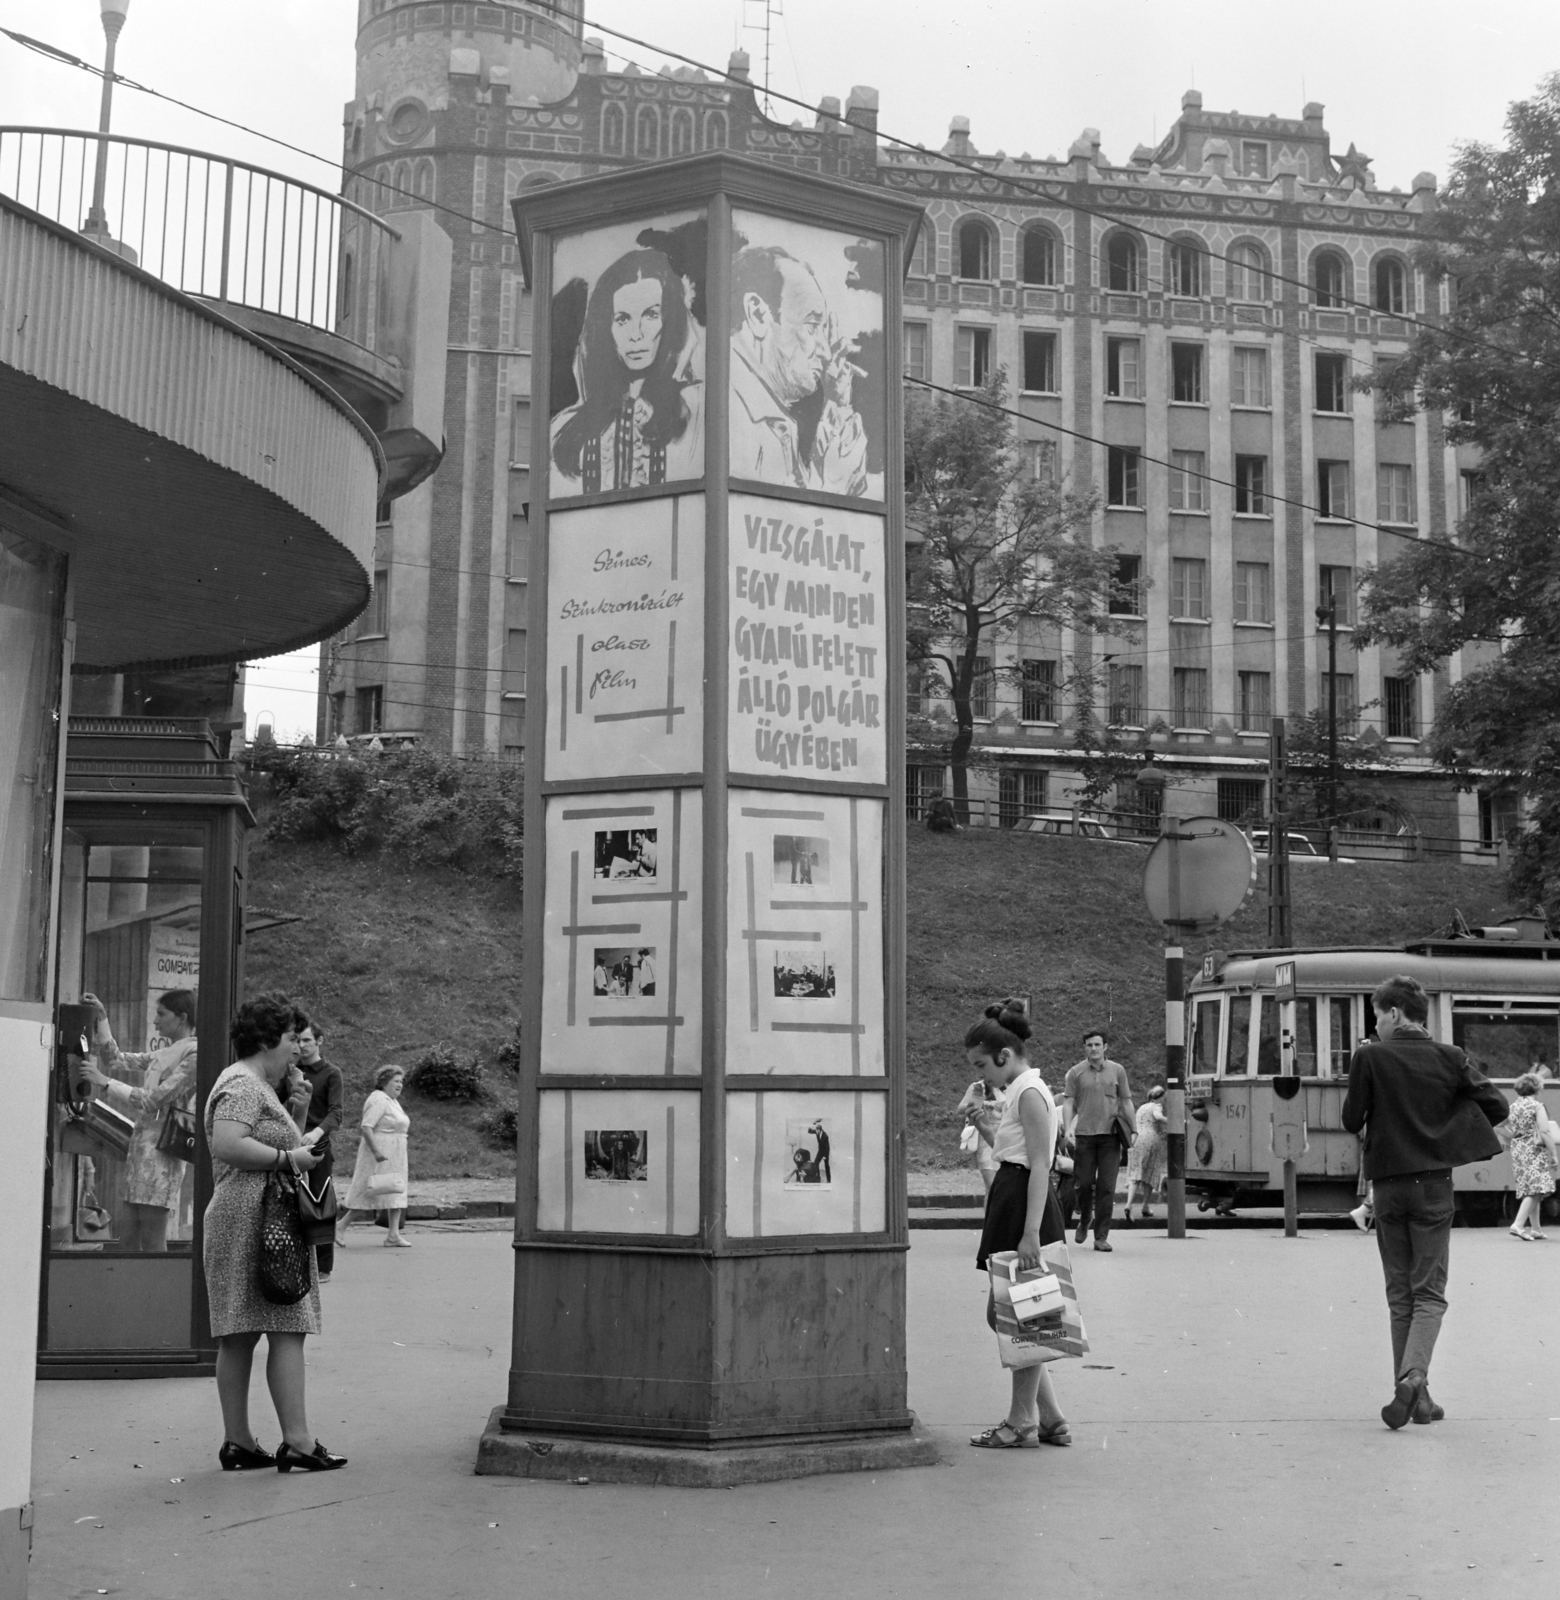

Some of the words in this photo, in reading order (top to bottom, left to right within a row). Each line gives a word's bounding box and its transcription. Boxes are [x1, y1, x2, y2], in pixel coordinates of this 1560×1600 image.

[744, 514, 871, 583] VIZSGÁLAT,
[736, 566, 779, 610] EGY
[784, 580, 875, 629] MINDEN
[591, 635, 651, 652] olasz
[735, 615, 808, 669] GYANÚ
[812, 633, 878, 679] FELETT
[737, 666, 791, 718] ÁLLÓ
[798, 679, 880, 729] POLGÁR
[755, 716, 858, 772] ÜGYÉBEN
[1204, 956, 1213, 976] 63
[1275, 965, 1291, 988] MM
[1225, 1104, 1246, 1119] 1547
[1011, 1333, 1037, 1344] CORVIN
